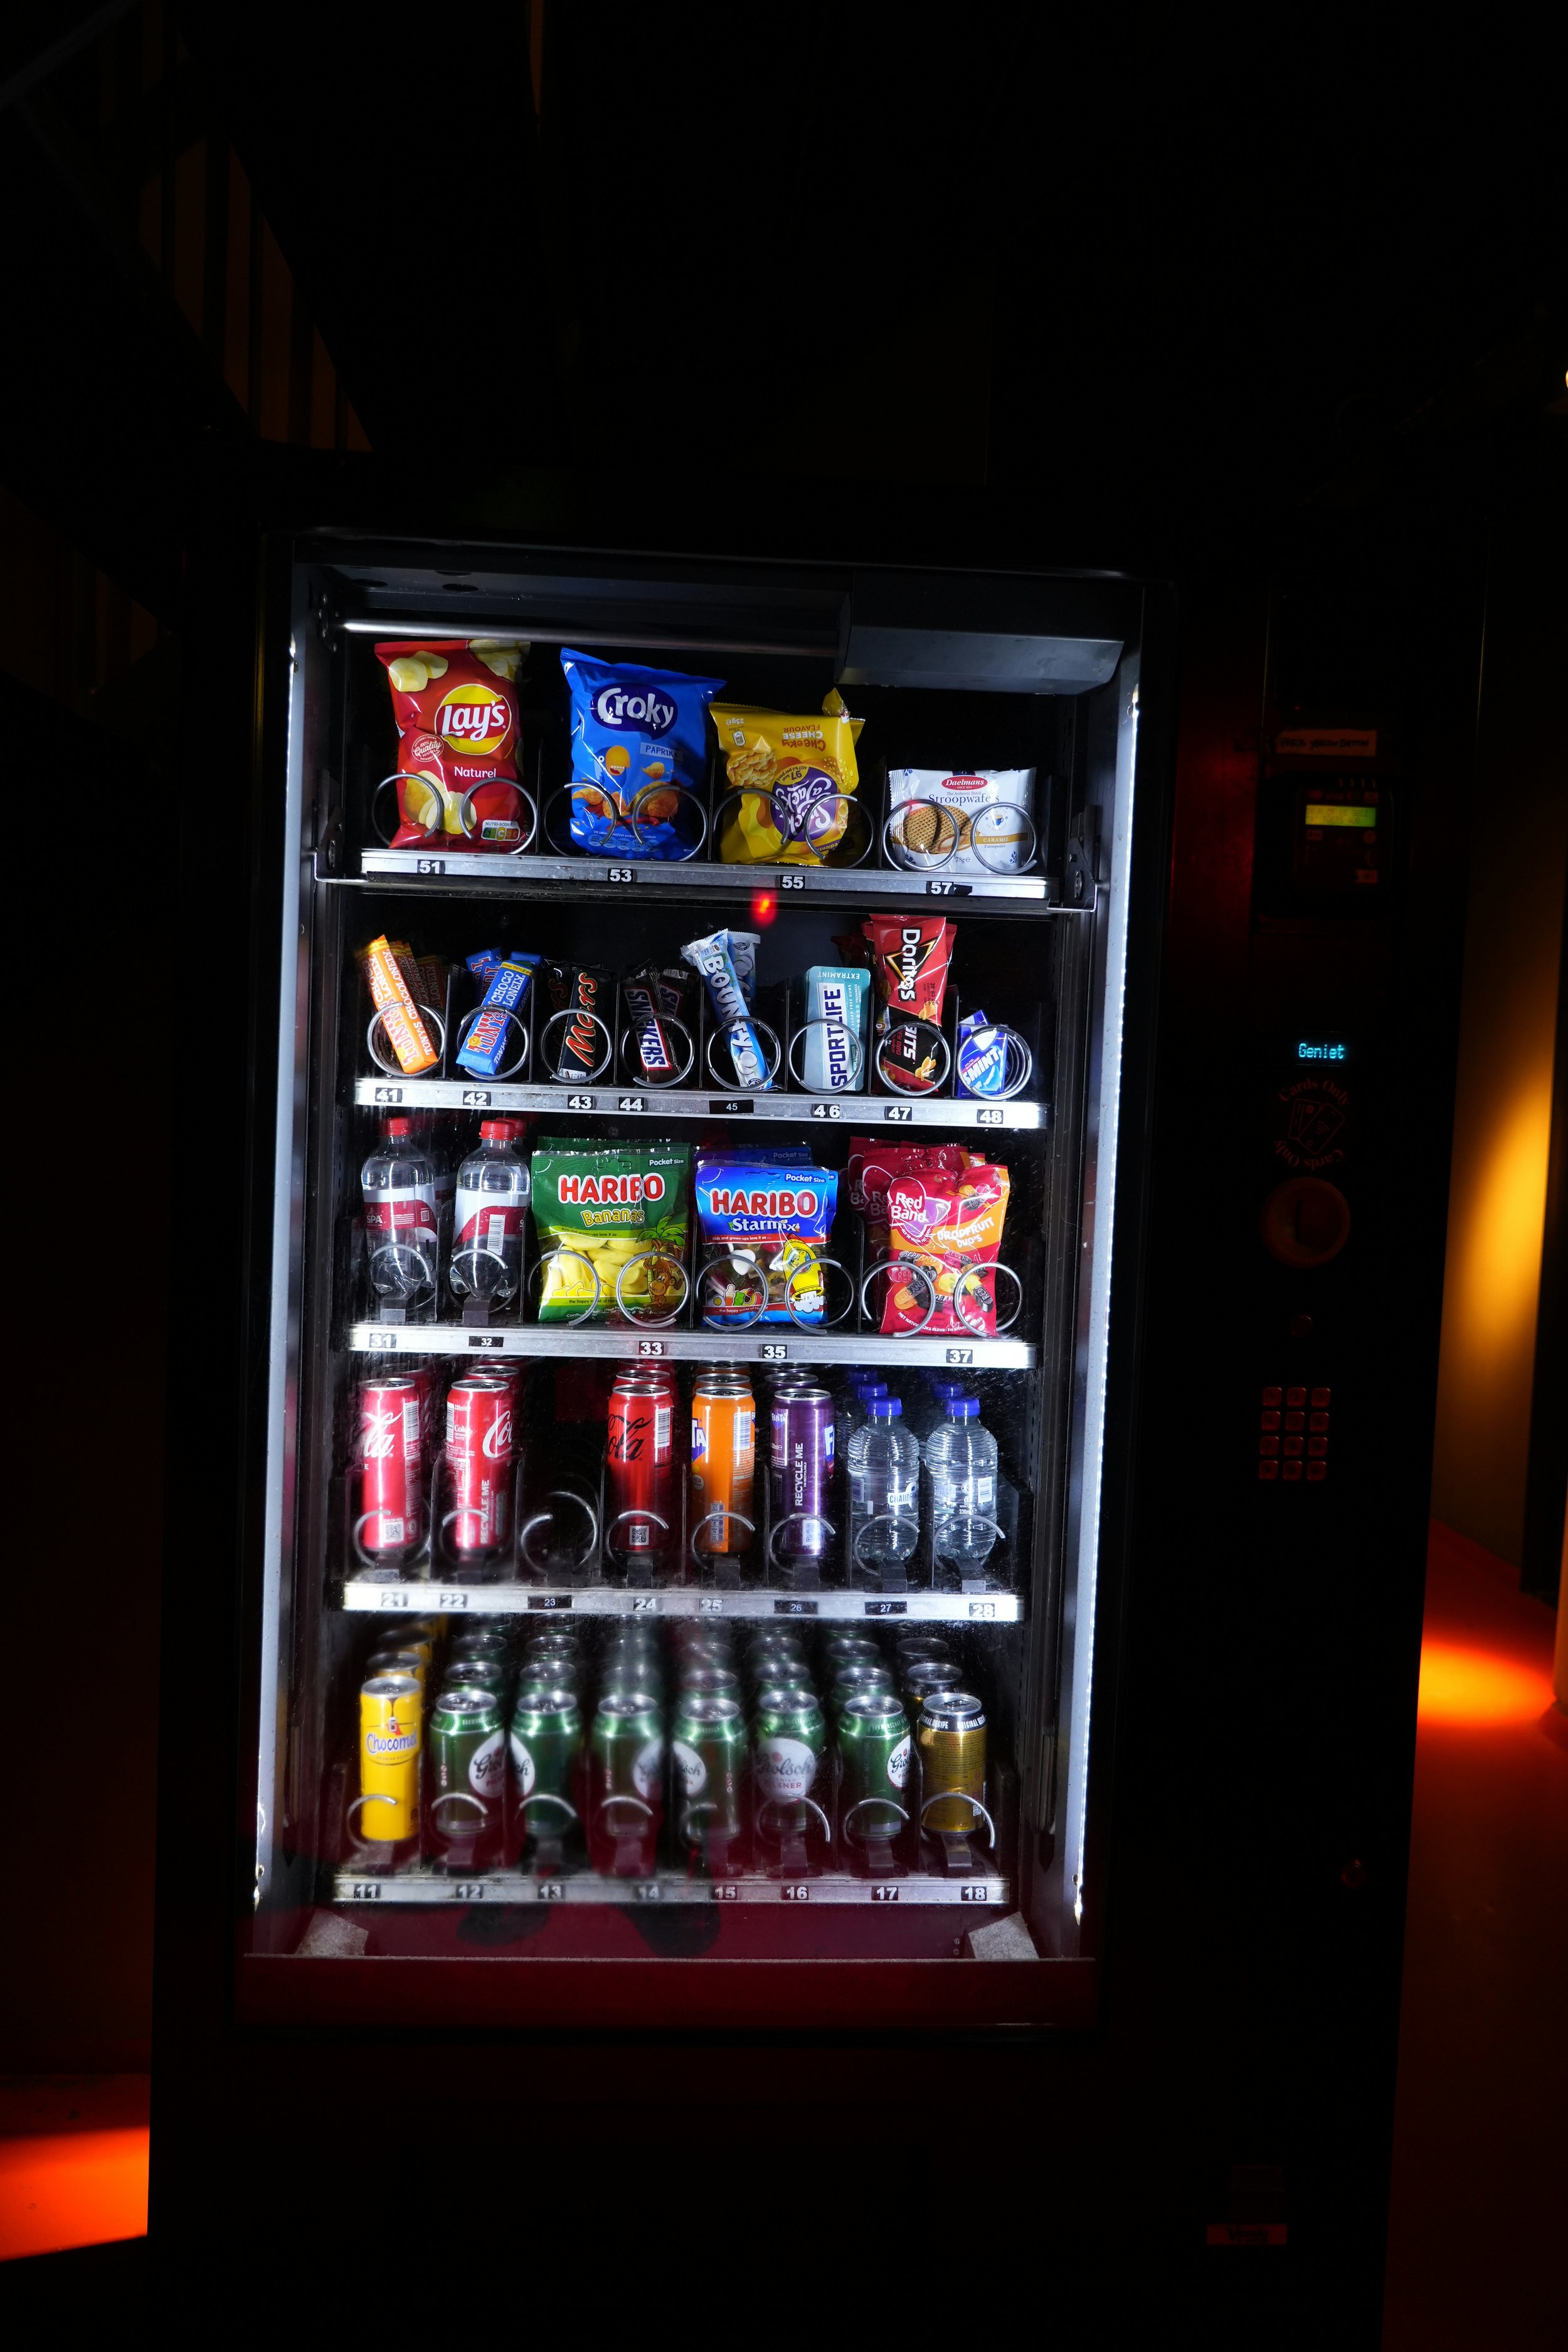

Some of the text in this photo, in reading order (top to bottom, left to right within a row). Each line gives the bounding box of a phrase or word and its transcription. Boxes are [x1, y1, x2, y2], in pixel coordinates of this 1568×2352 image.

[597, 687, 674, 729] Croky
[442, 700, 506, 741] Lay's
[782, 731, 823, 740] CHEESE
[784, 724, 820, 733] FLAVOUR
[413, 740, 442, 757] Quality
[645, 744, 679, 760] PAPRIKA
[454, 766, 497, 778] Naturel
[791, 770, 802, 780] 97
[928, 793, 1000, 806] Stroopwafes
[419, 861, 440, 875] 51
[610, 869, 632, 882] 53
[781, 876, 804, 889] 55
[930, 881, 953, 895] 57
[898, 929, 920, 1002] Doritos
[818, 972, 861, 980] EXTRAMINT
[490, 970, 514, 1003] CHOCO
[702, 955, 753, 1048] BOUNTY
[565, 972, 598, 1067] Mars
[413, 1020, 433, 1056] TONY'S
[824, 989, 847, 1087] SPORTLIFE
[1298, 1042, 1345, 1059] Geniet
[962, 1047, 999, 1085] SMINT
[376, 1088, 400, 1102] 41
[1278, 1074, 1351, 1106] Cards Only
[464, 1092, 487, 1105] 42
[569, 1096, 591, 1110] 43
[620, 1098, 643, 1111] 44
[814, 1105, 840, 1118] 46
[889, 1107, 911, 1120] 47
[980, 1110, 1002, 1123] 48
[1303, 1148, 1345, 1172] Cards
[786, 1173, 812, 1182] Pocket
[559, 1174, 665, 1204] HARIBO
[710, 1189, 818, 1217] HARIBO
[896, 1192, 922, 1209] Red
[366, 1215, 383, 1224] SPA
[581, 1208, 645, 1227] Bananas
[891, 1206, 928, 1223] Band
[733, 1218, 797, 1232] Starmix
[937, 1217, 995, 1241] DROPFRUIT
[956, 1234, 982, 1248] DUO'S
[371, 1335, 393, 1348] 31
[481, 1338, 493, 1346] 32
[640, 1342, 662, 1355] 33
[764, 1346, 785, 1359] 35
[950, 1350, 972, 1364] 37
[795, 1443, 803, 1507] RECYCLE ME
[482, 1480, 489, 1496] ME
[382, 1594, 406, 1608] 21
[441, 1594, 466, 1608] 22
[544, 1598, 556, 1607] 23
[635, 1598, 656, 1611] 24
[701, 1599, 723, 1612] 25
[790, 1603, 802, 1612] 26
[881, 1604, 891, 1613] 27
[972, 1604, 993, 1616] 28
[932, 1719, 948, 1729] RECIPE
[367, 1730, 418, 1754] Chocomel
[357, 1884, 377, 1899] 11
[458, 1885, 481, 1899] 12
[539, 1884, 562, 1900] 13
[638, 1884, 660, 1899] 14
[715, 1885, 736, 1900] 15
[787, 1886, 808, 1900] 16
[876, 1887, 898, 1901] 17
[964, 1887, 986, 1901] 18
